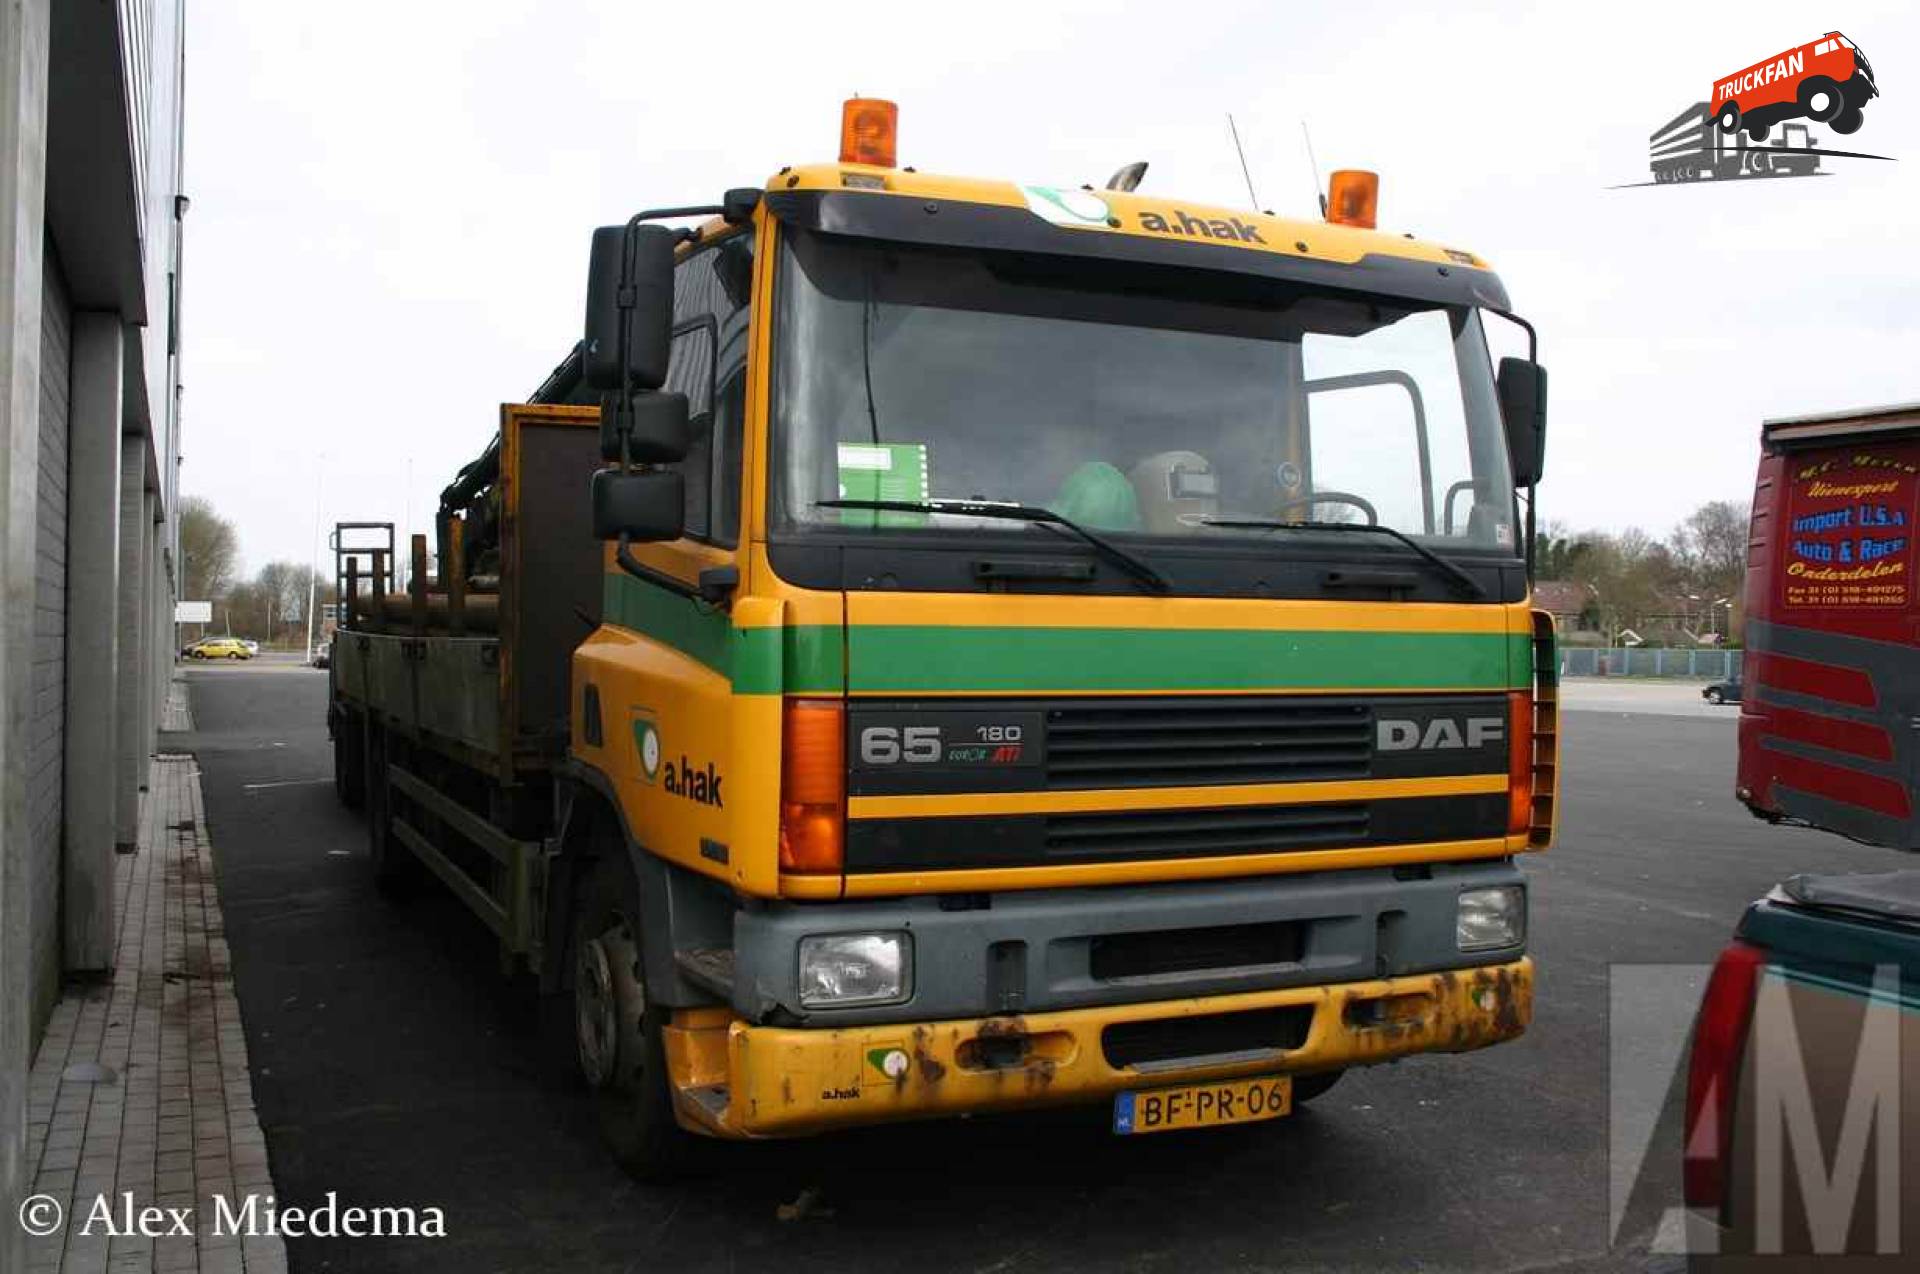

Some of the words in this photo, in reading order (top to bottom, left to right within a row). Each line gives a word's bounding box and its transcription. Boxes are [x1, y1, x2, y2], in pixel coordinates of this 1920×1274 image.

[1138, 209, 1268, 245] a.hak
[1793, 507, 1853, 533] Import
[1793, 540, 1832, 562] Auto
[1838, 540, 1852, 563] &
[861, 726, 942, 764] 65
[976, 726, 1021, 741] 180
[1377, 717, 1504, 750] DAF
[664, 754, 723, 811] a.hak
[822, 1087, 860, 1100] a.hak
